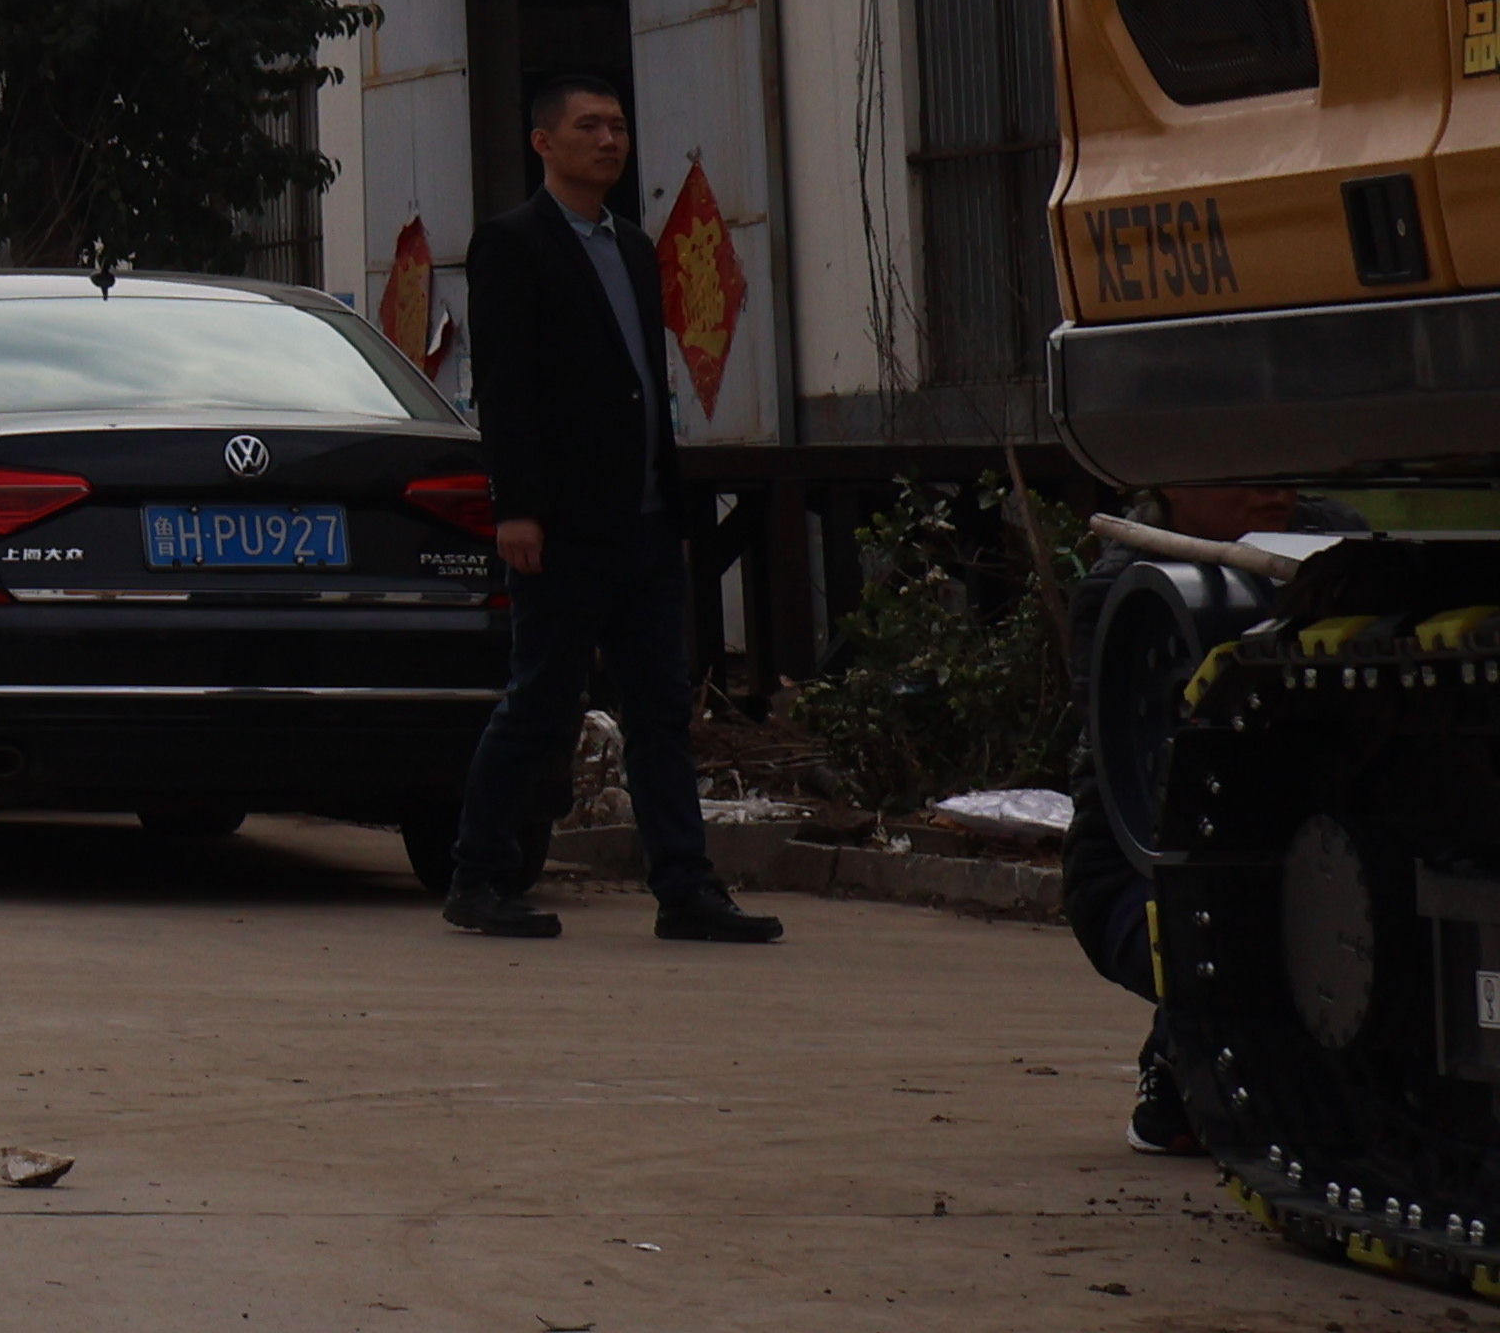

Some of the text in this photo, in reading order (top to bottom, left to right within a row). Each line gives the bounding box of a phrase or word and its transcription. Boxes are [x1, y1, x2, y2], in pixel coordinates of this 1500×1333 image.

[1084, 197, 1239, 304] XE75GA
[0, 547, 85, 562] 上海大众
[419, 552, 489, 566] PASSAT
